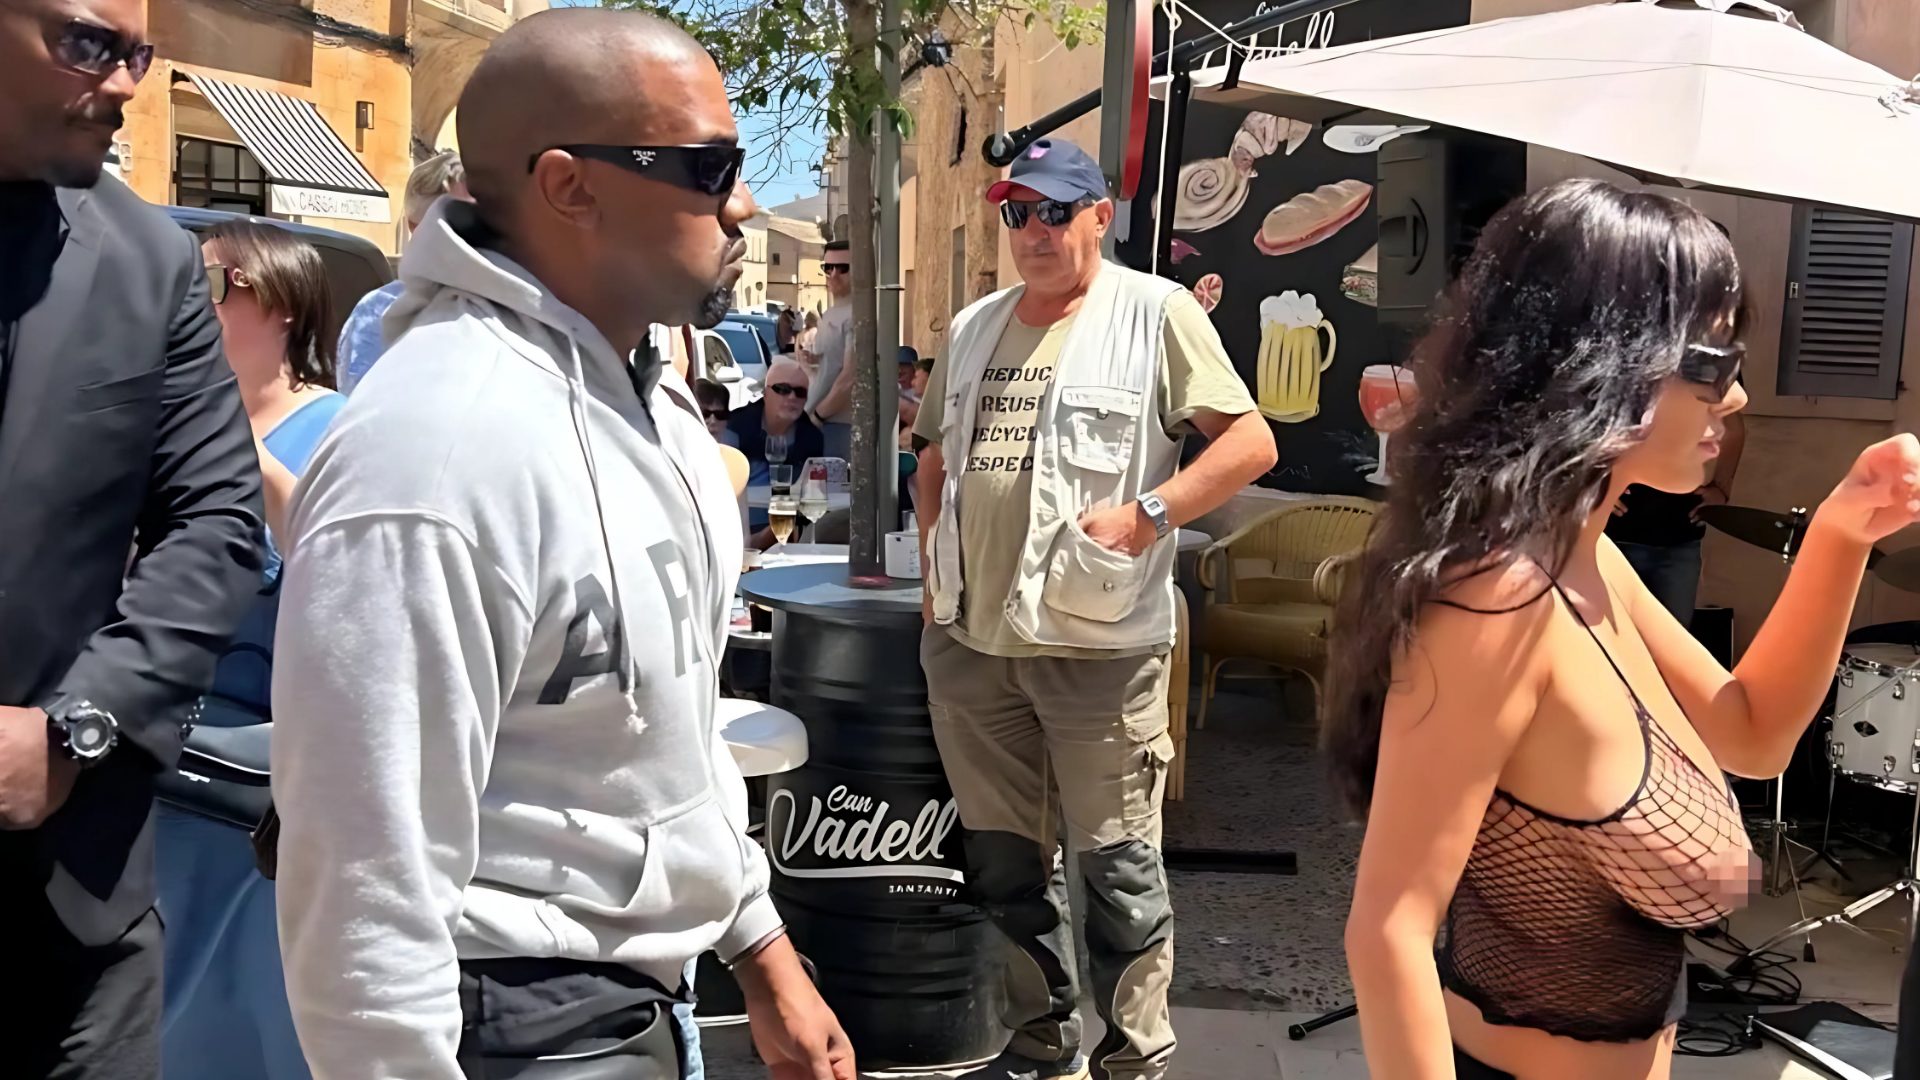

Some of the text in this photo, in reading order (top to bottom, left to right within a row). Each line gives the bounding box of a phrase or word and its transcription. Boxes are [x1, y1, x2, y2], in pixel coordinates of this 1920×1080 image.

[981, 366, 1053, 382] REDUC
[827, 785, 874, 813] Can
[769, 788, 958, 863] Vadell
